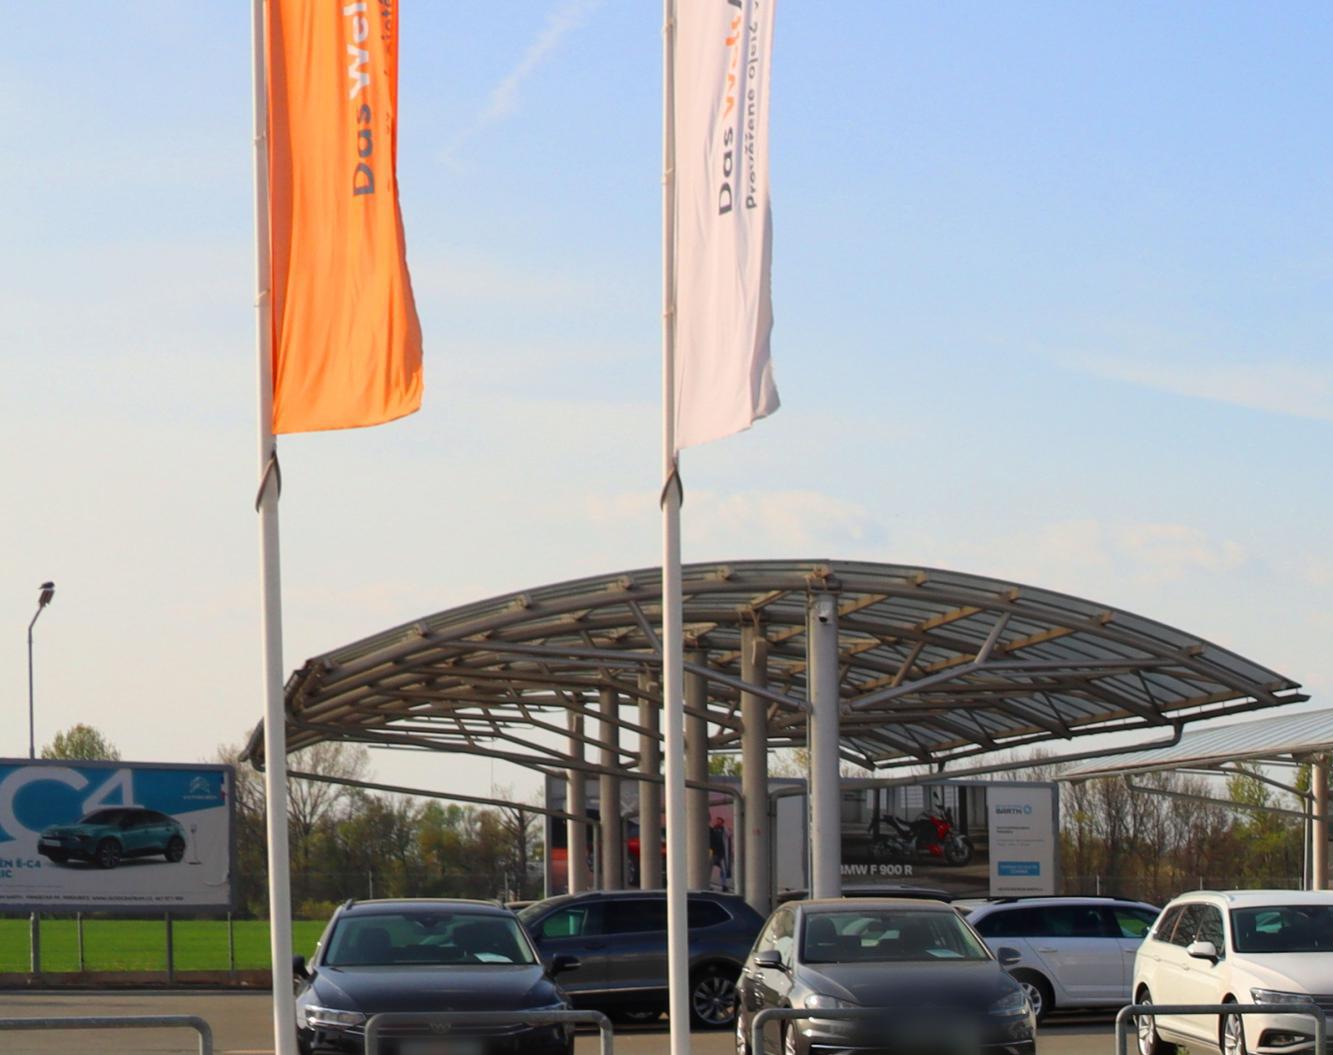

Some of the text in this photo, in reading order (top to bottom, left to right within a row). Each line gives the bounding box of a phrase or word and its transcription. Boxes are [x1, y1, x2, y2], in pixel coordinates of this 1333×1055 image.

[352, 103, 375, 196] Das
[718, 126, 734, 215] Das
[870, 864, 877, 875] F
[880, 864, 901, 875] 900
[905, 864, 913, 875] R
